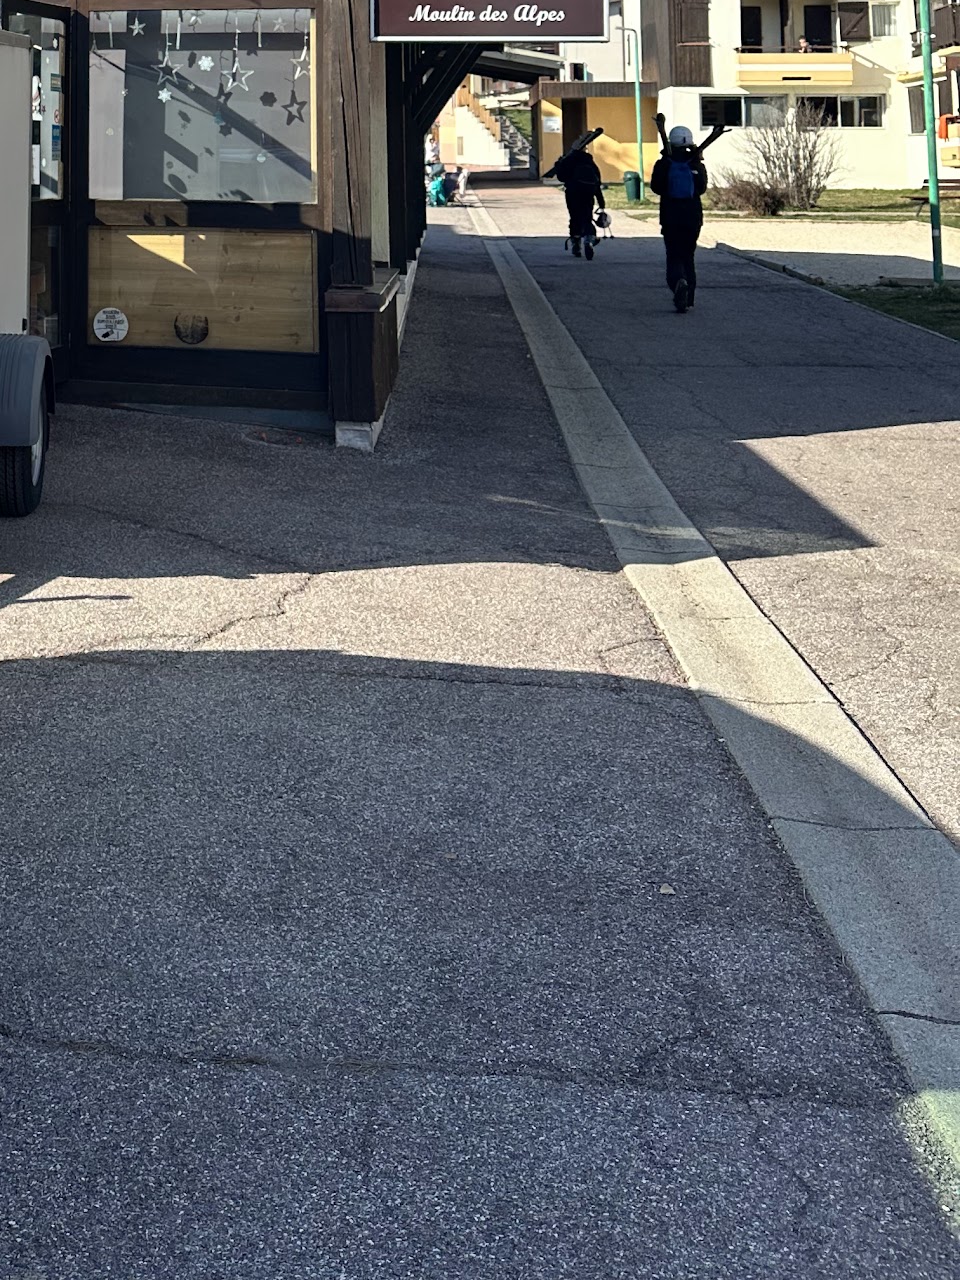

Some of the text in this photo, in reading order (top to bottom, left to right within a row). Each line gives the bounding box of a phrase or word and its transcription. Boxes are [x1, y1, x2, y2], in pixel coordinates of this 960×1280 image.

[409, 5, 565, 26] Moulin des Alpes
